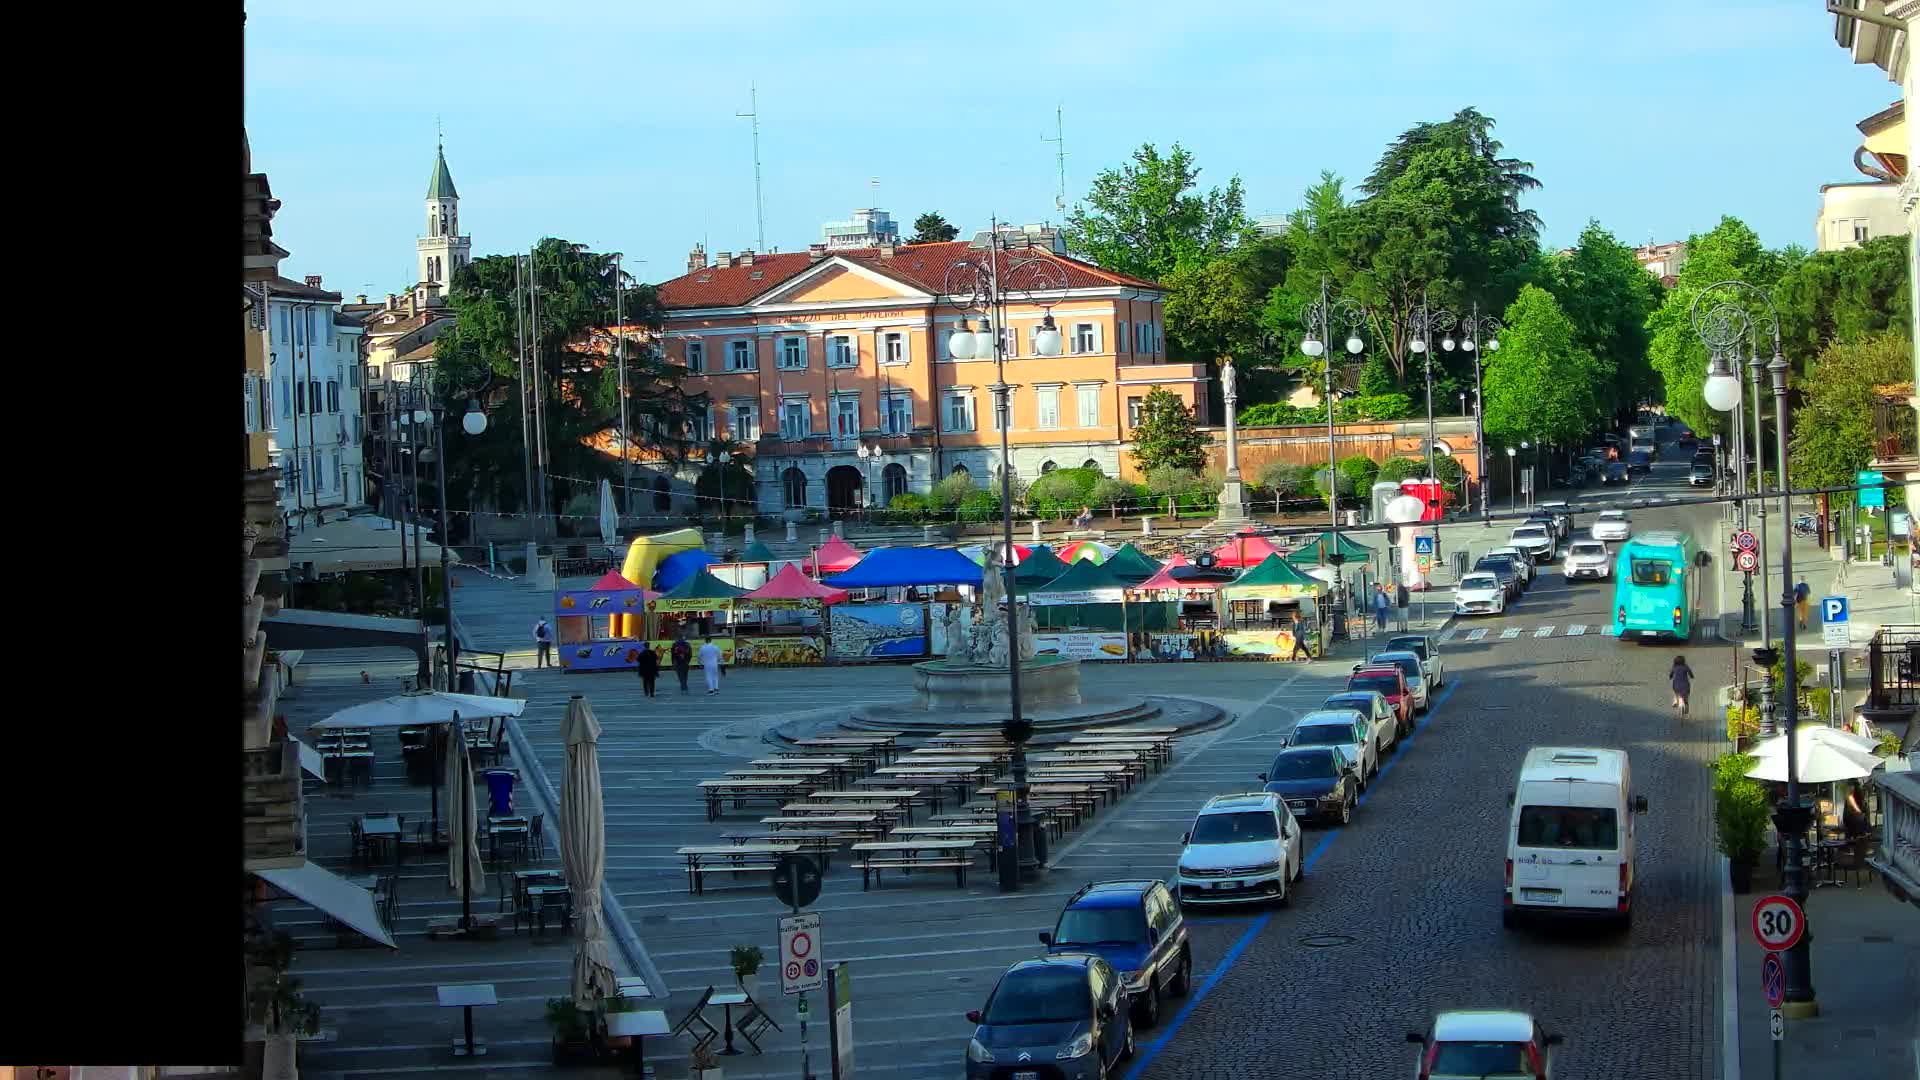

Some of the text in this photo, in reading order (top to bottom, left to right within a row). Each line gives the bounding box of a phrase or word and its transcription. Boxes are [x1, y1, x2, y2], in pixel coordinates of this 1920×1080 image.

[1743, 557, 1752, 565] 20
[1827, 600, 1842, 621] P
[1762, 910, 1791, 937] 30
